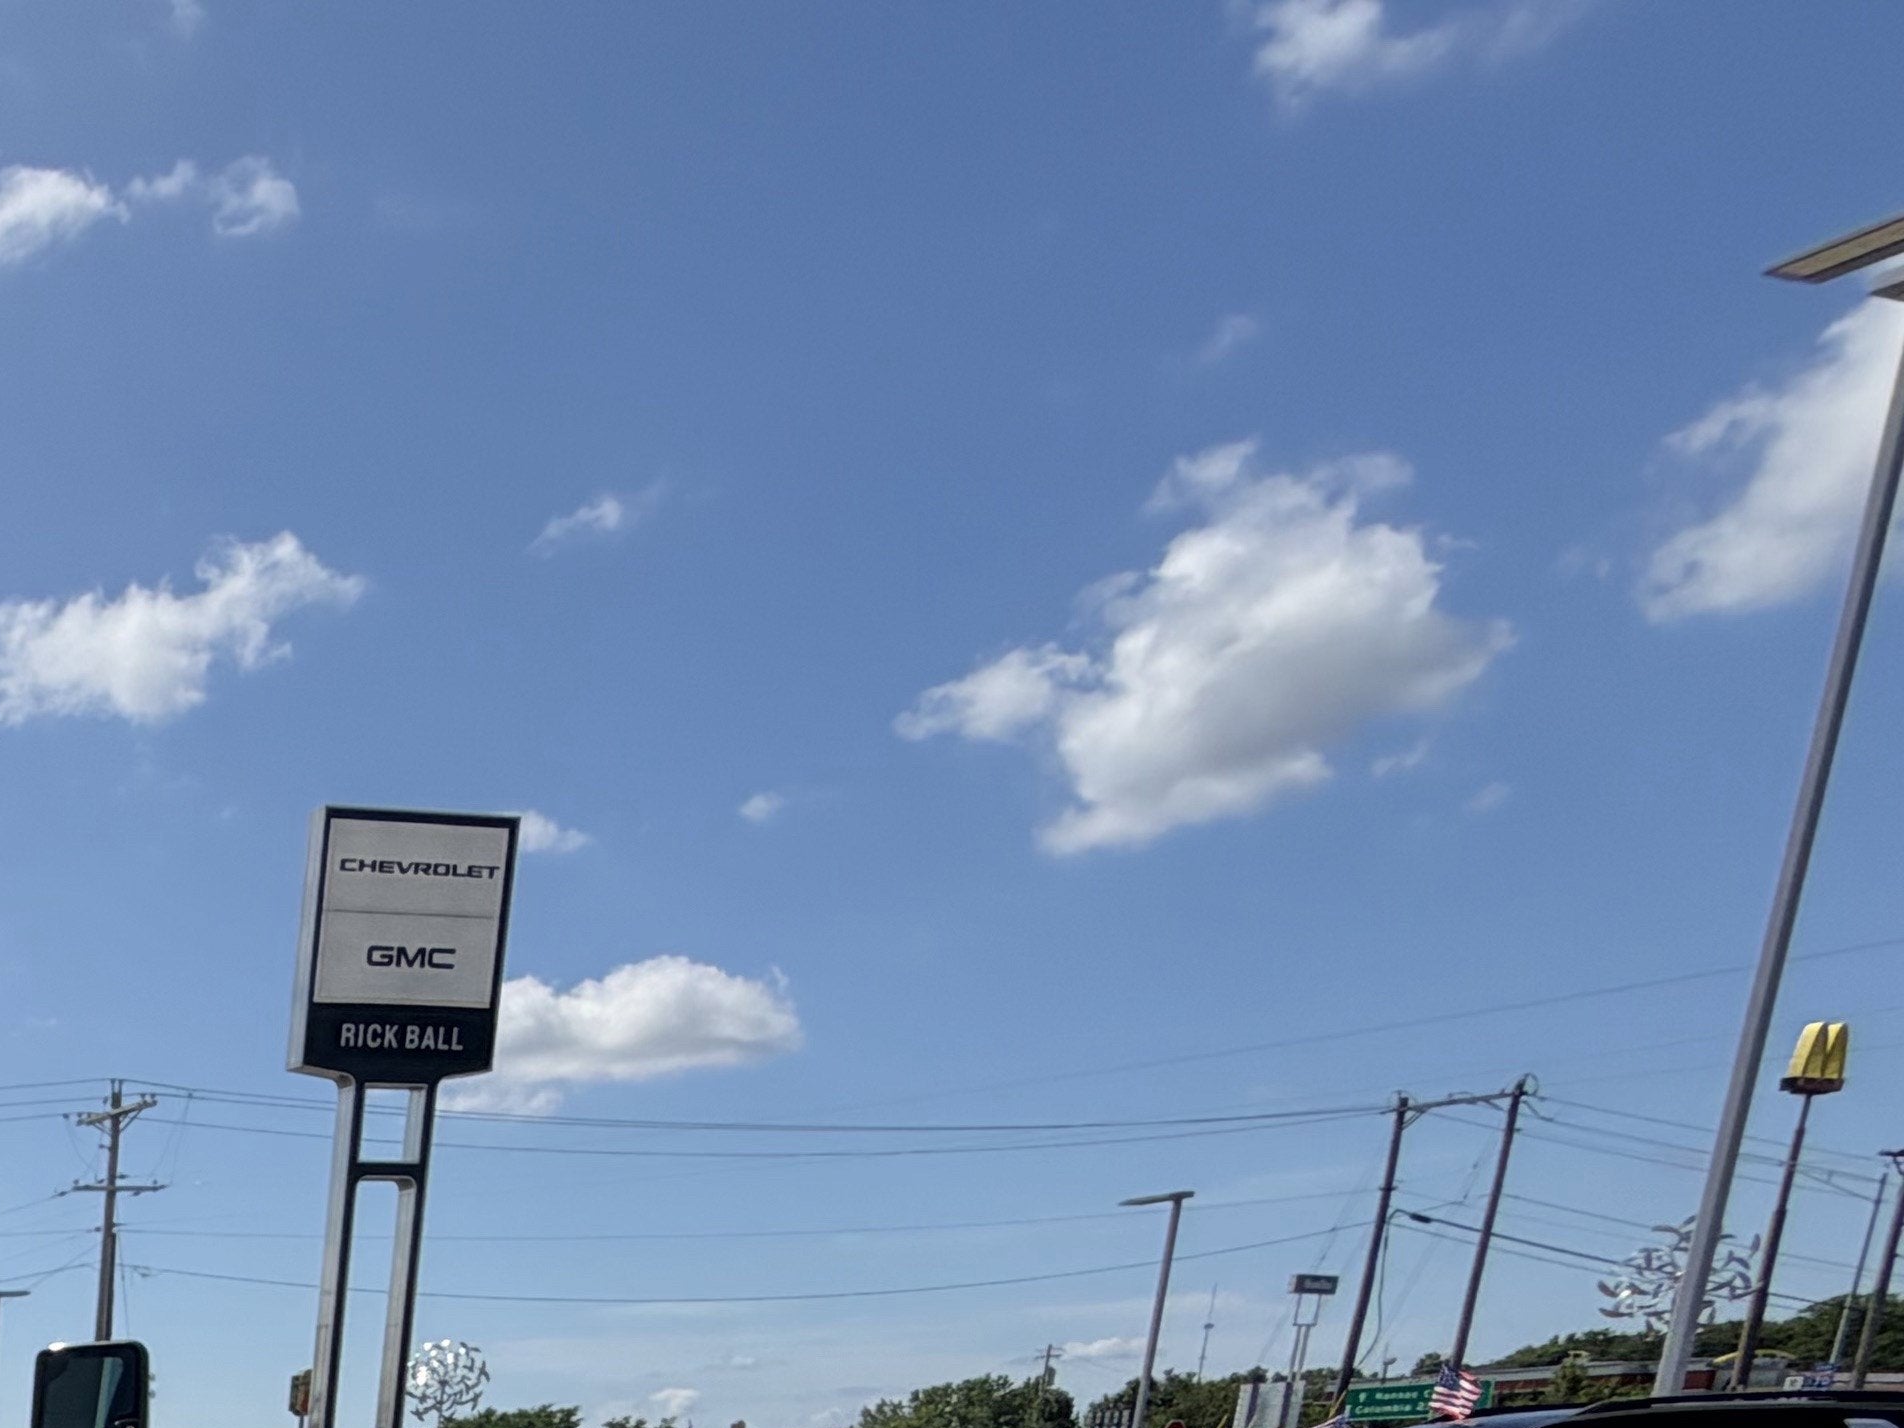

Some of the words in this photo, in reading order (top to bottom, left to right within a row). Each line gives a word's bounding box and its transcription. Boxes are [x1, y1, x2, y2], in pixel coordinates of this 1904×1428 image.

[339, 858, 500, 879] CHEVROLET
[366, 945, 456, 969] GMC
[340, 1023, 398, 1049] RICK
[405, 1025, 464, 1051] BALL
